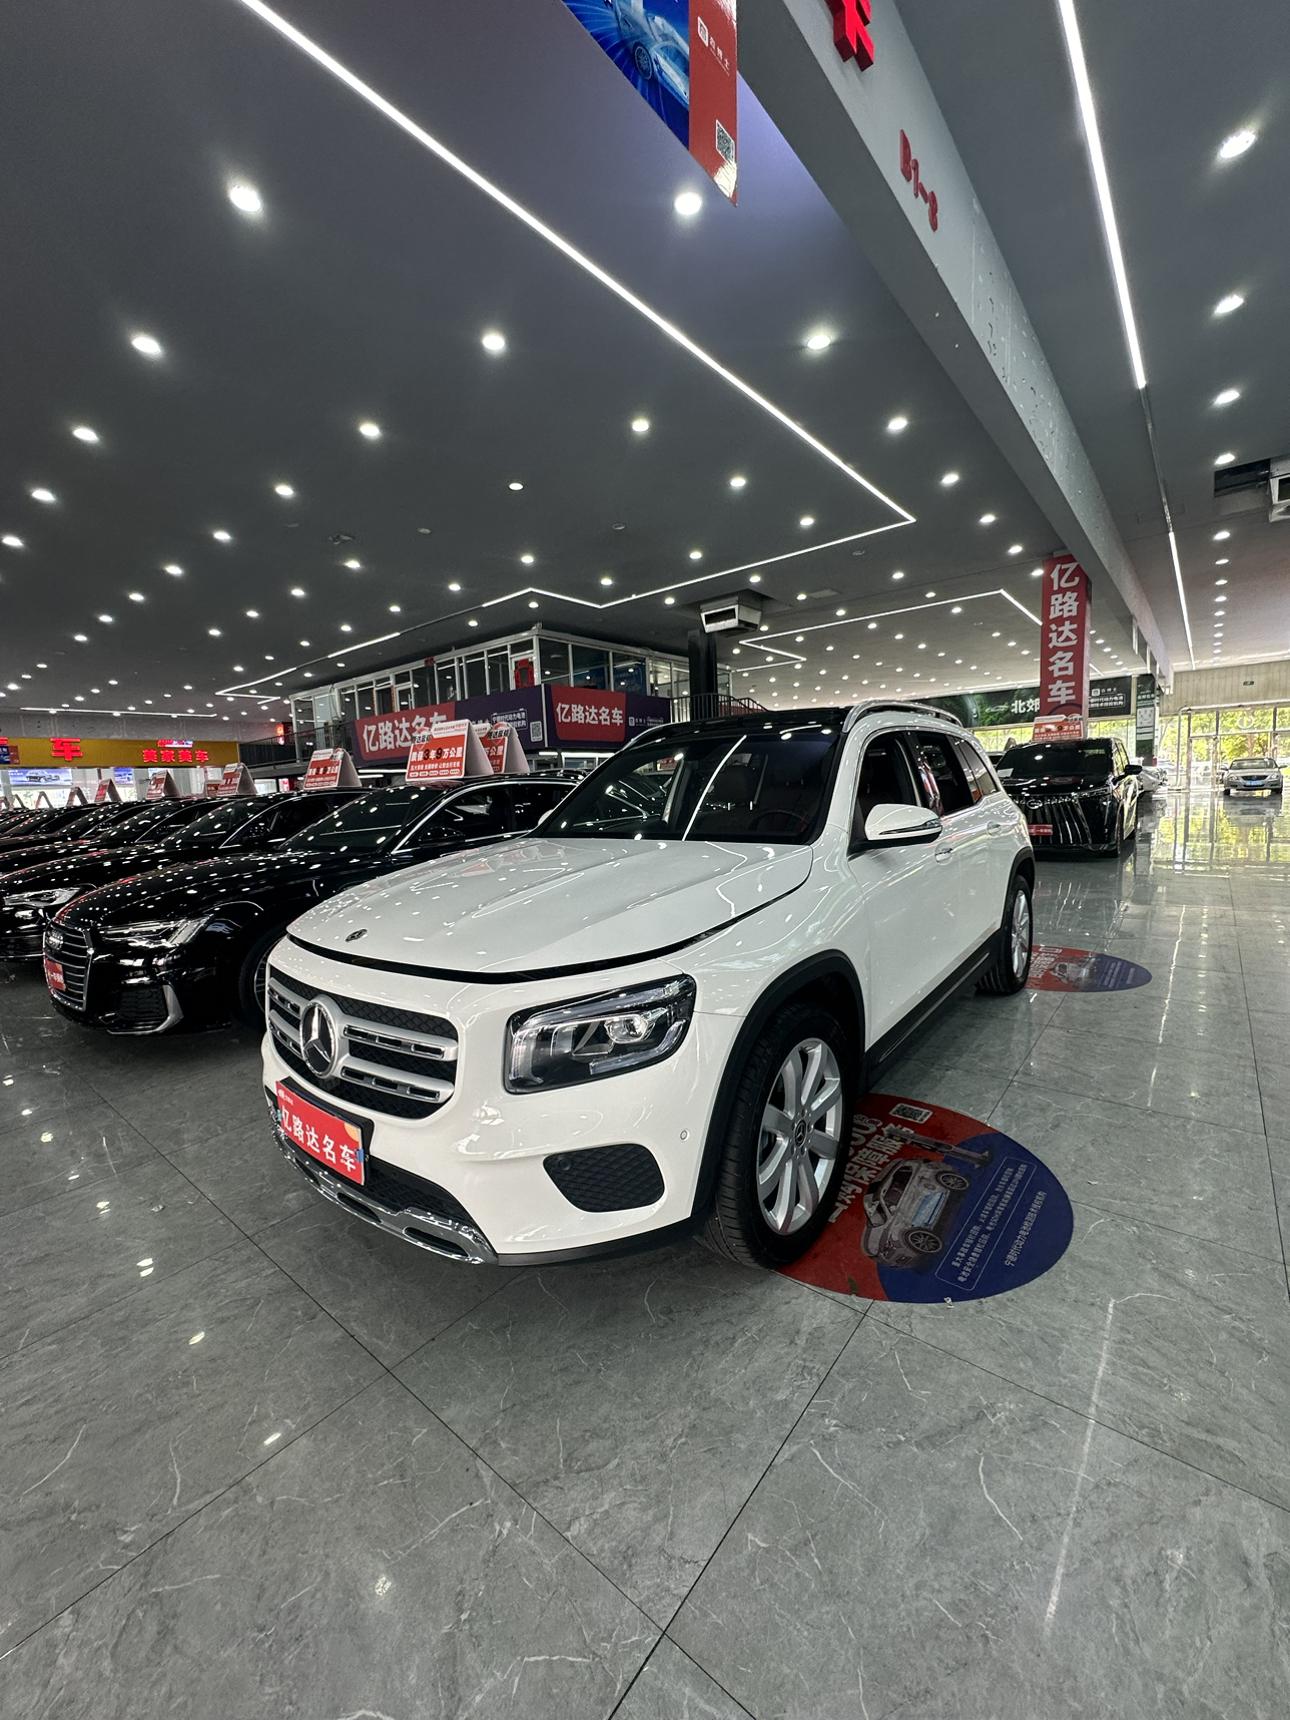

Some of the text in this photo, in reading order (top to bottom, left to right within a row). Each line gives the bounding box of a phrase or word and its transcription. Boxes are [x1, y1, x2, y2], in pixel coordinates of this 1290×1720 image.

[1047, 561, 1080, 705] 亿路达名车
[556, 703, 624, 726] 亿路达名车
[49, 737, 83, 762] 车
[281, 1104, 357, 1172] 亿路达名车
